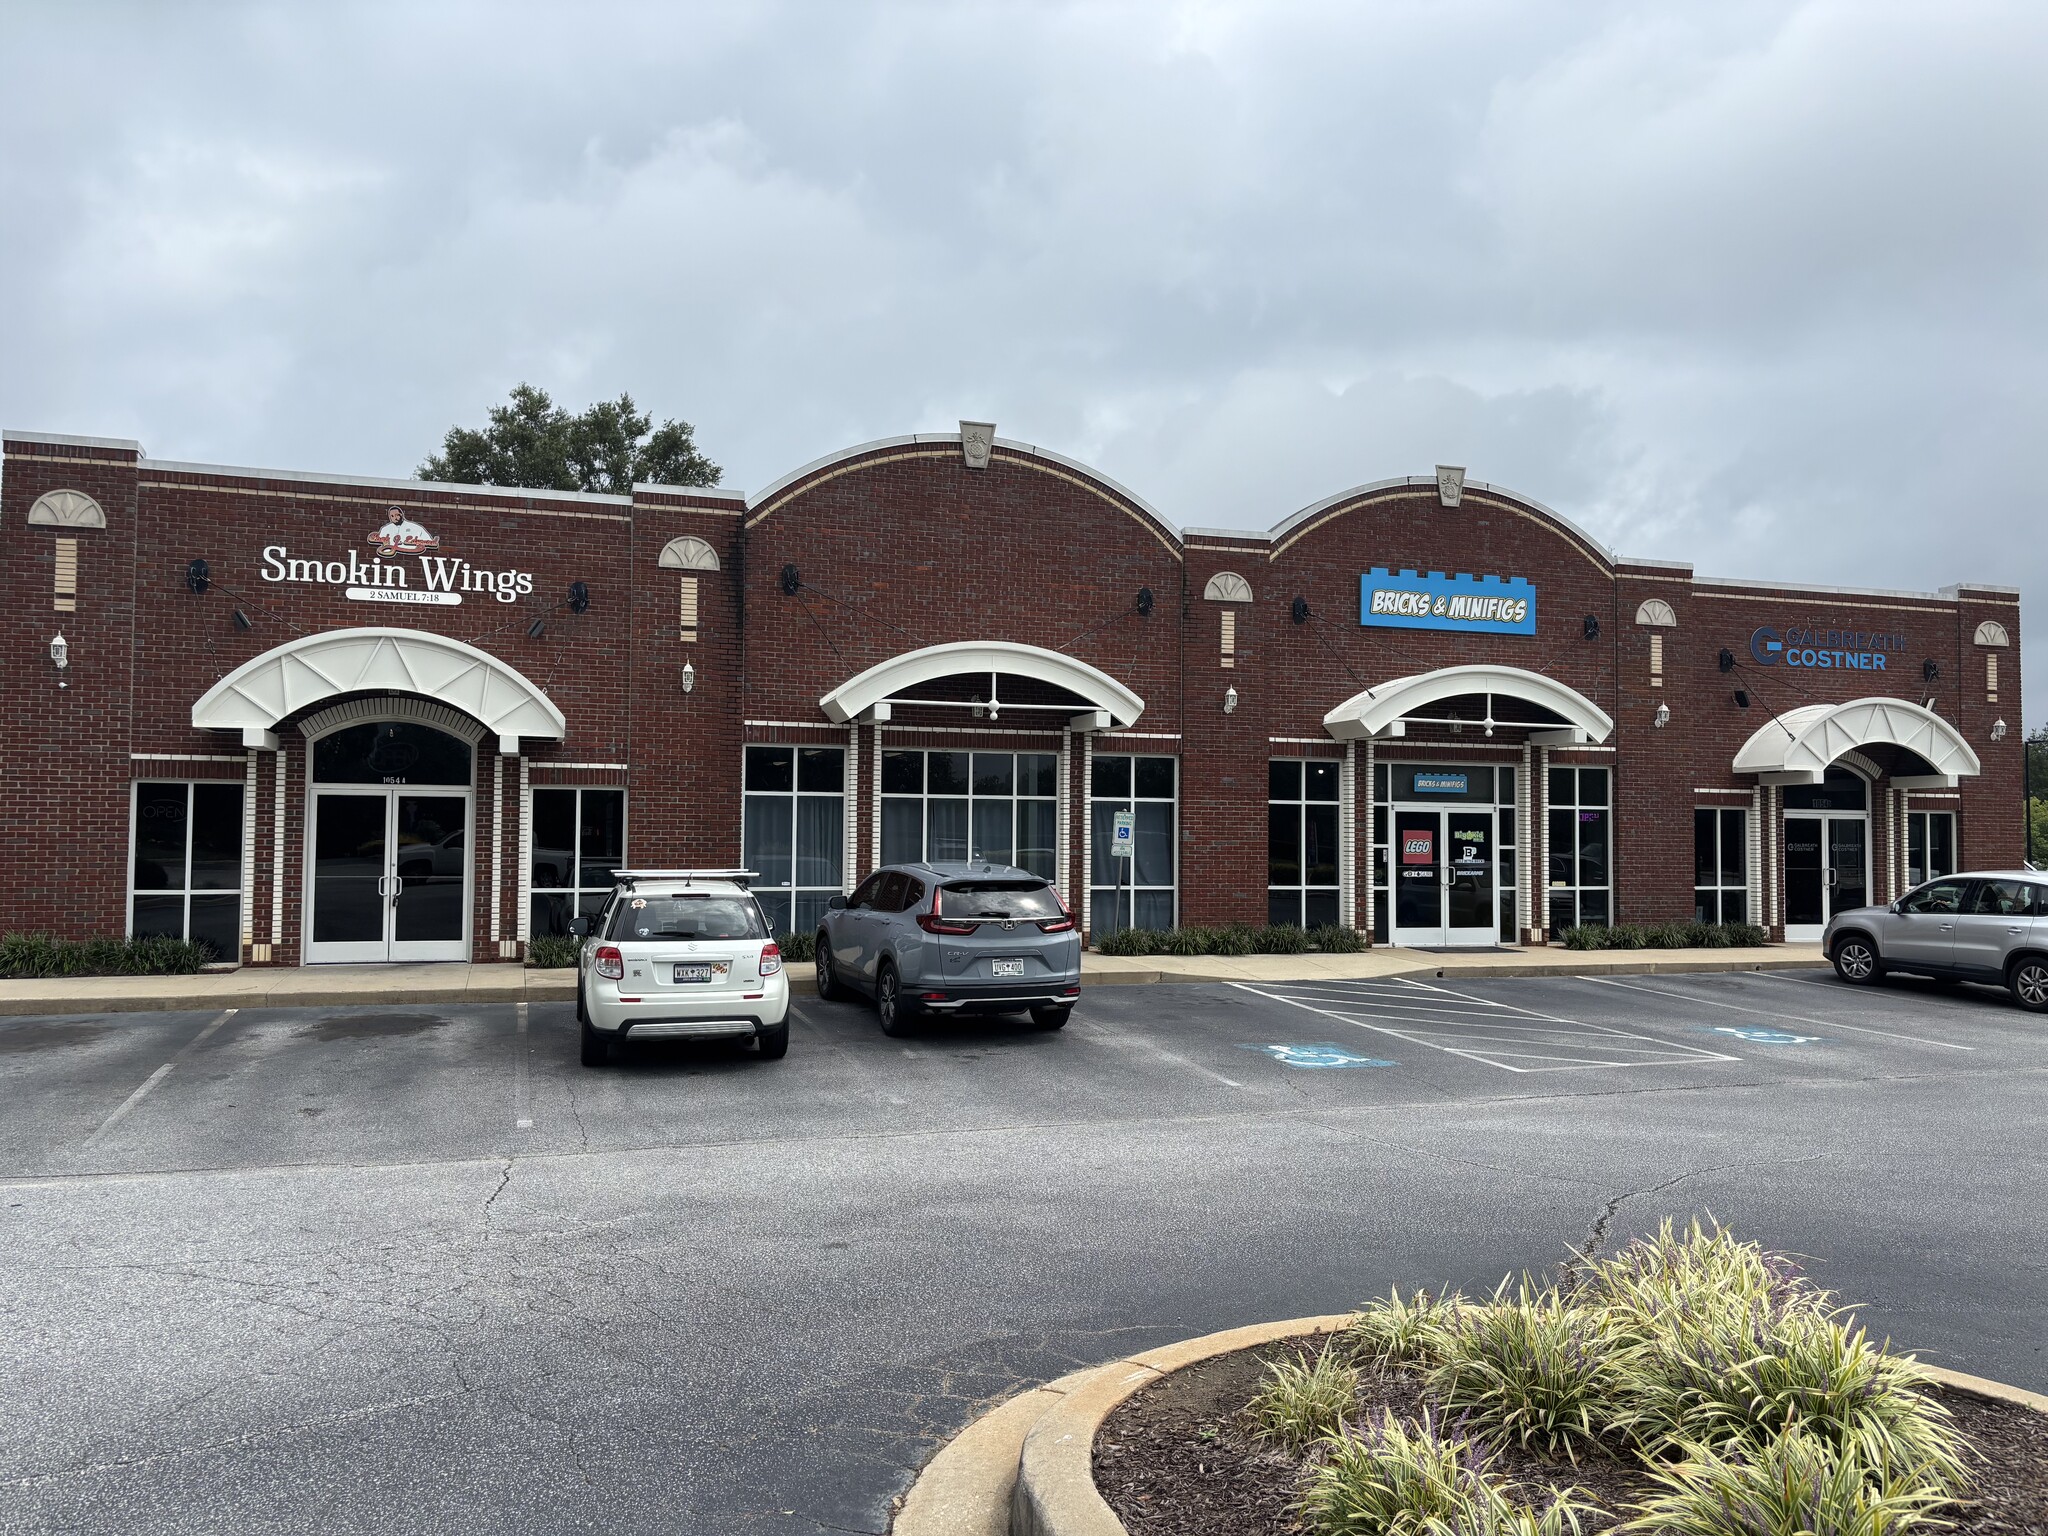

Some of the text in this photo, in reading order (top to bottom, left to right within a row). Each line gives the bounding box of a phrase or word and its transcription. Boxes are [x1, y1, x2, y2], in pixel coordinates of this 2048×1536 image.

[261, 545, 533, 602] Smokin Wings
[370, 591, 439, 602] 2 SAMUEL 7:18
[1371, 589, 1527, 622] BRICKS & MINIFIGS
[1786, 627, 1905, 651] GALBREATH
[1786, 649, 1886, 670] COSTNER
[1417, 780, 1436, 788] BRICKS
[1405, 840, 1431, 854] LEGO
[676, 968, 690, 978] WXK
[696, 968, 709, 978] 327
